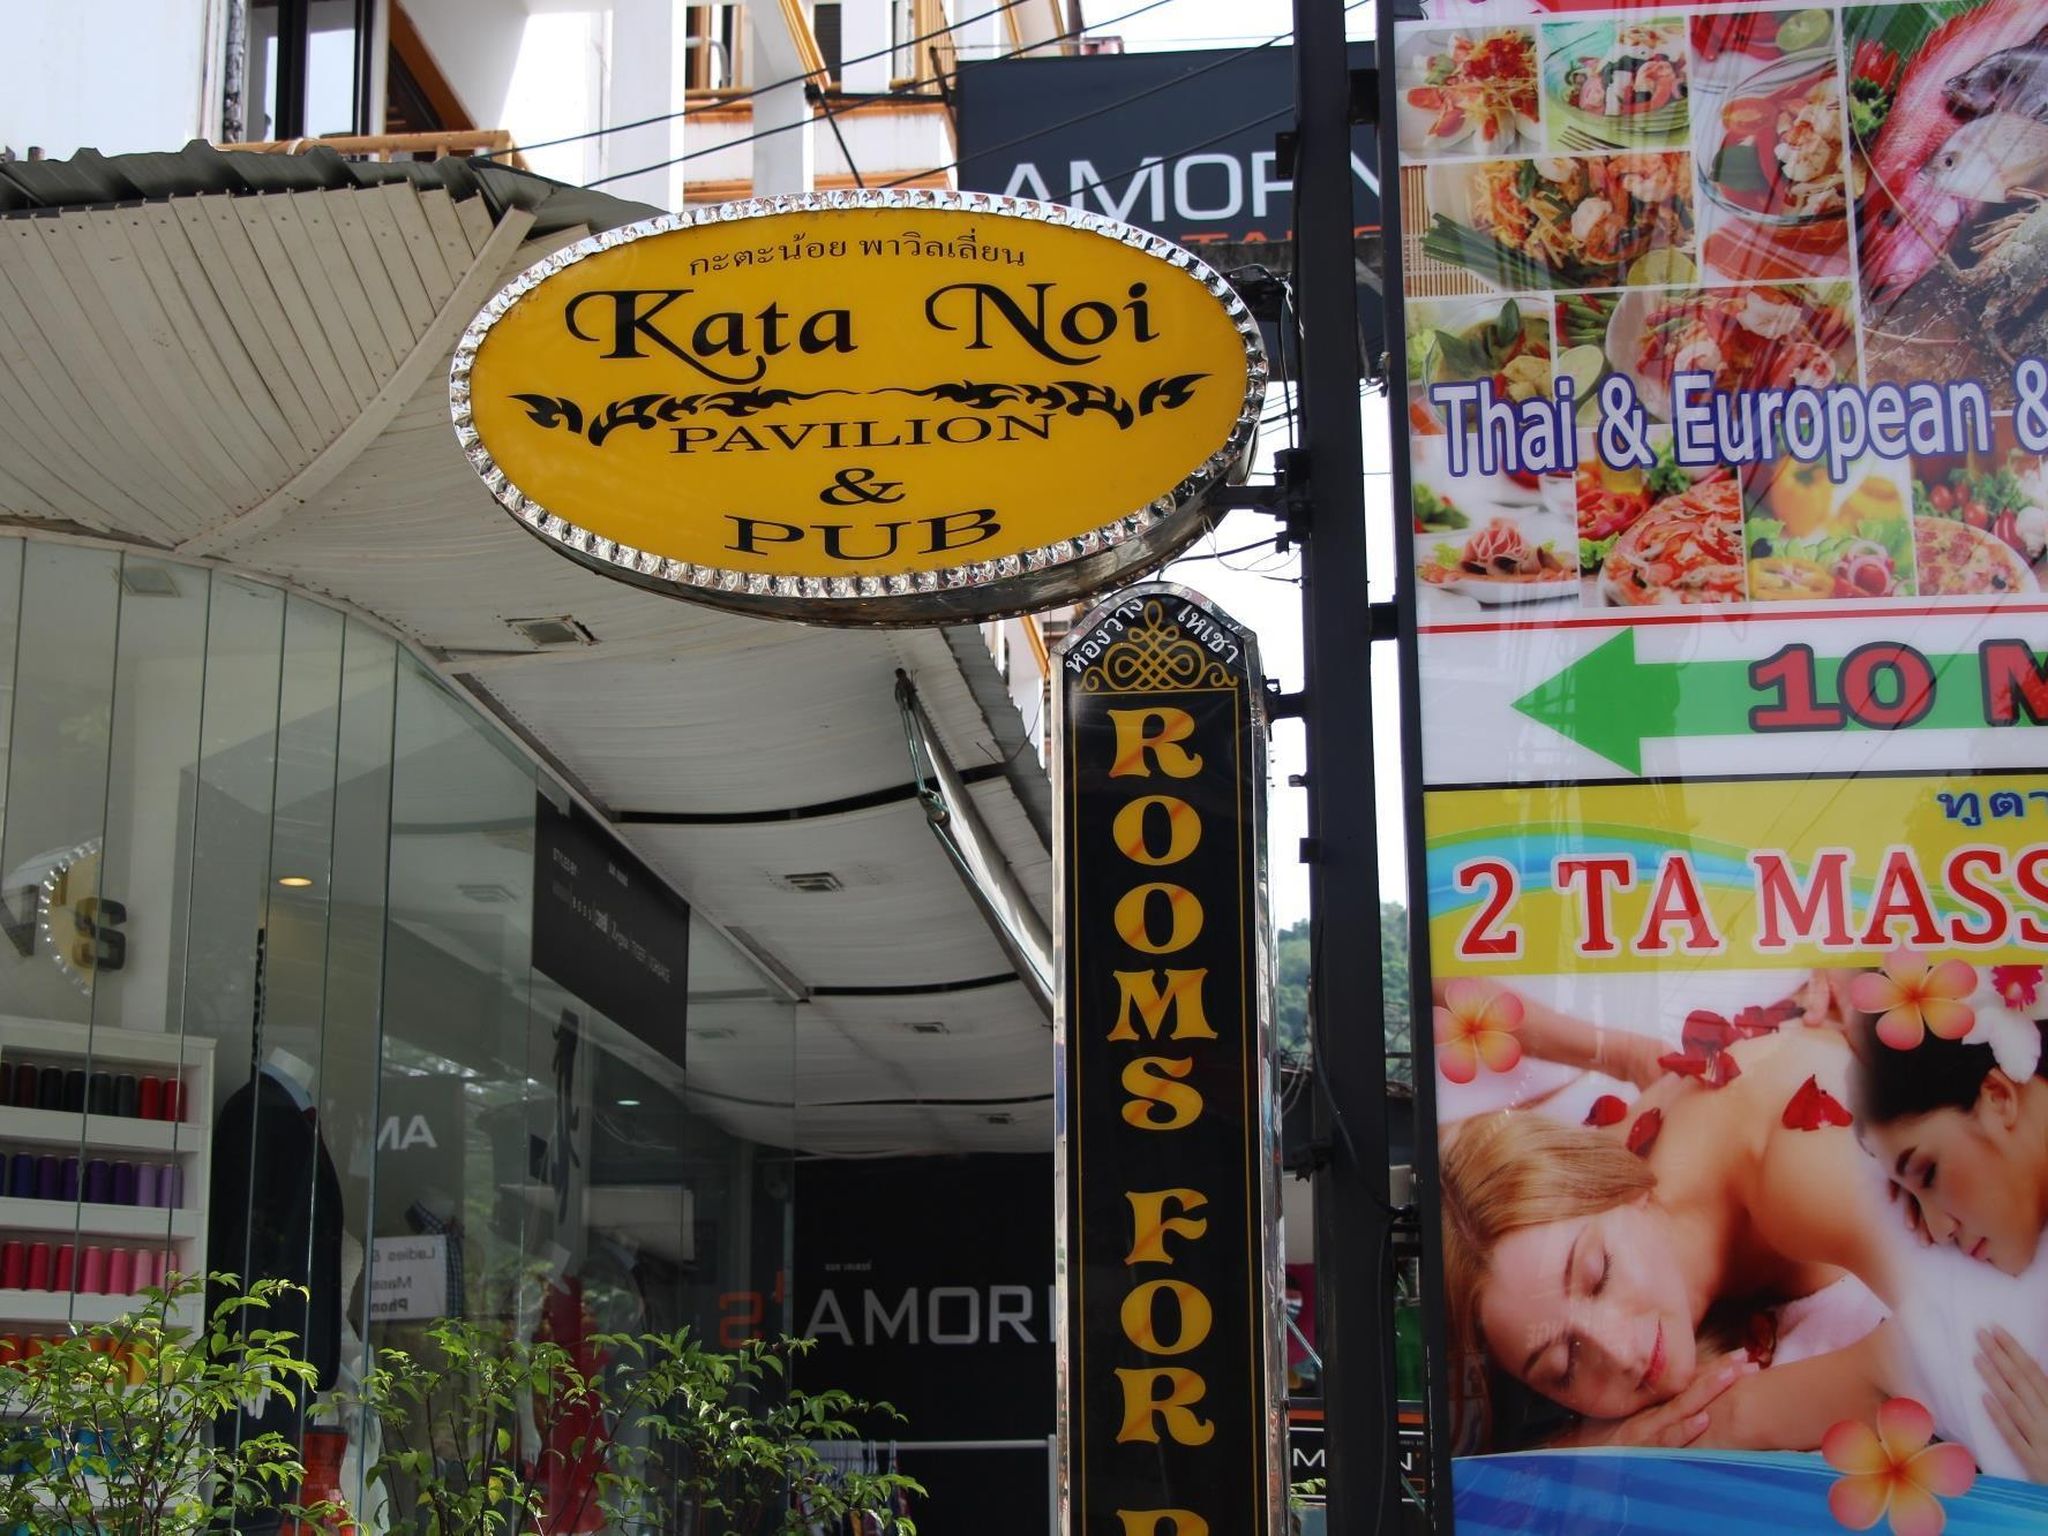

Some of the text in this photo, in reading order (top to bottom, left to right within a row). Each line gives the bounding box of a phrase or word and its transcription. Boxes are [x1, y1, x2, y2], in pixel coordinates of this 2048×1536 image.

[1003, 151, 1380, 223] AMO
[689, 228, 1026, 276] กะตะน้อย พาวิลเลี่ยน
[564, 280, 1160, 382] Kata Noi
[669, 411, 1052, 454] PAVILION
[1431, 376, 1578, 477] Thai
[1599, 374, 1655, 469] &
[1673, 370, 1990, 482] European
[818, 466, 908, 506] &
[722, 507, 1002, 561] PUB
[1749, 642, 1937, 732] 10
[1106, 706, 1219, 1132] ROOMS
[1458, 861, 1520, 956] 2
[1556, 855, 1721, 954] TA
[804, 1284, 1056, 1347] AMOR
[1113, 1187, 1216, 1447] FOR
